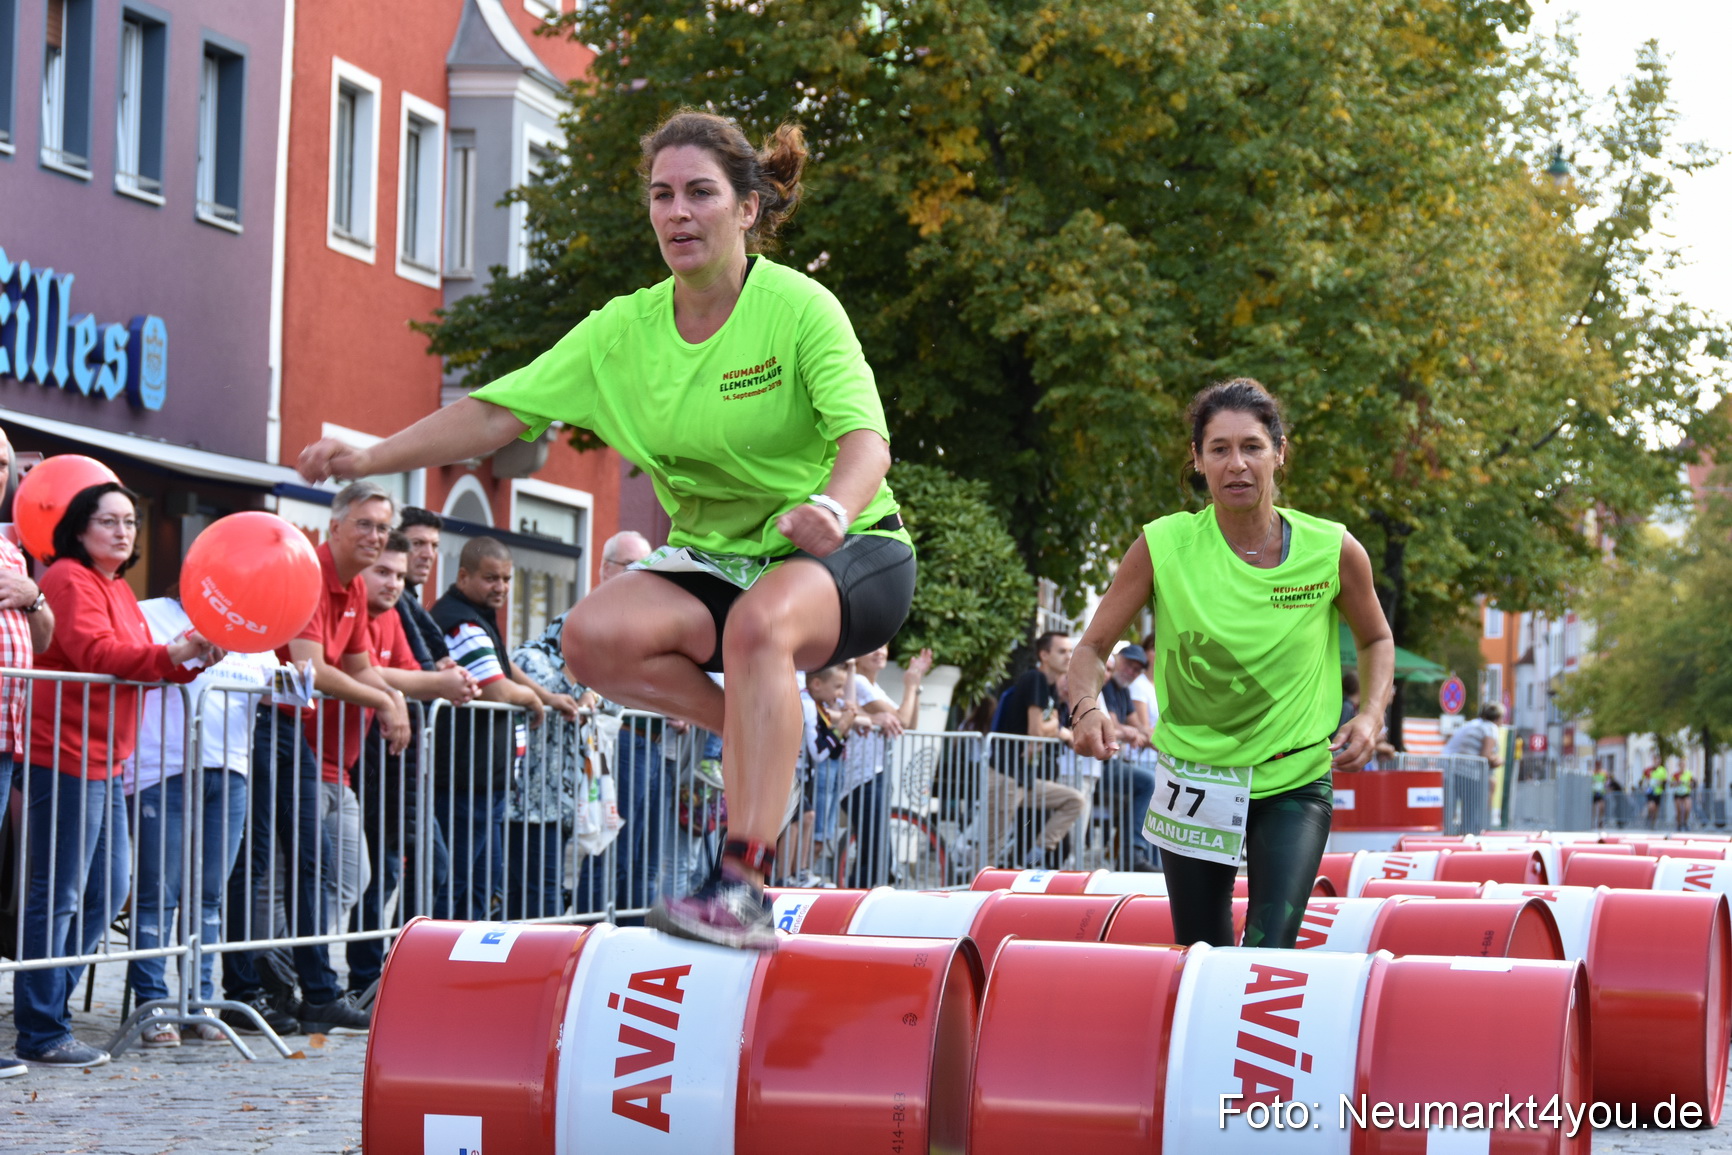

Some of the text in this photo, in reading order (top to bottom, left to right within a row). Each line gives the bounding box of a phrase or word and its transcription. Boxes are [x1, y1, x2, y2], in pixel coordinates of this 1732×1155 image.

[720, 365, 783, 392] ELEMENTELAUF
[732, 387, 768, 400] September
[1273, 581, 1329, 593] NEUMARKTER
[1166, 780, 1206, 818] 77
[1147, 814, 1225, 850] MANUELA
